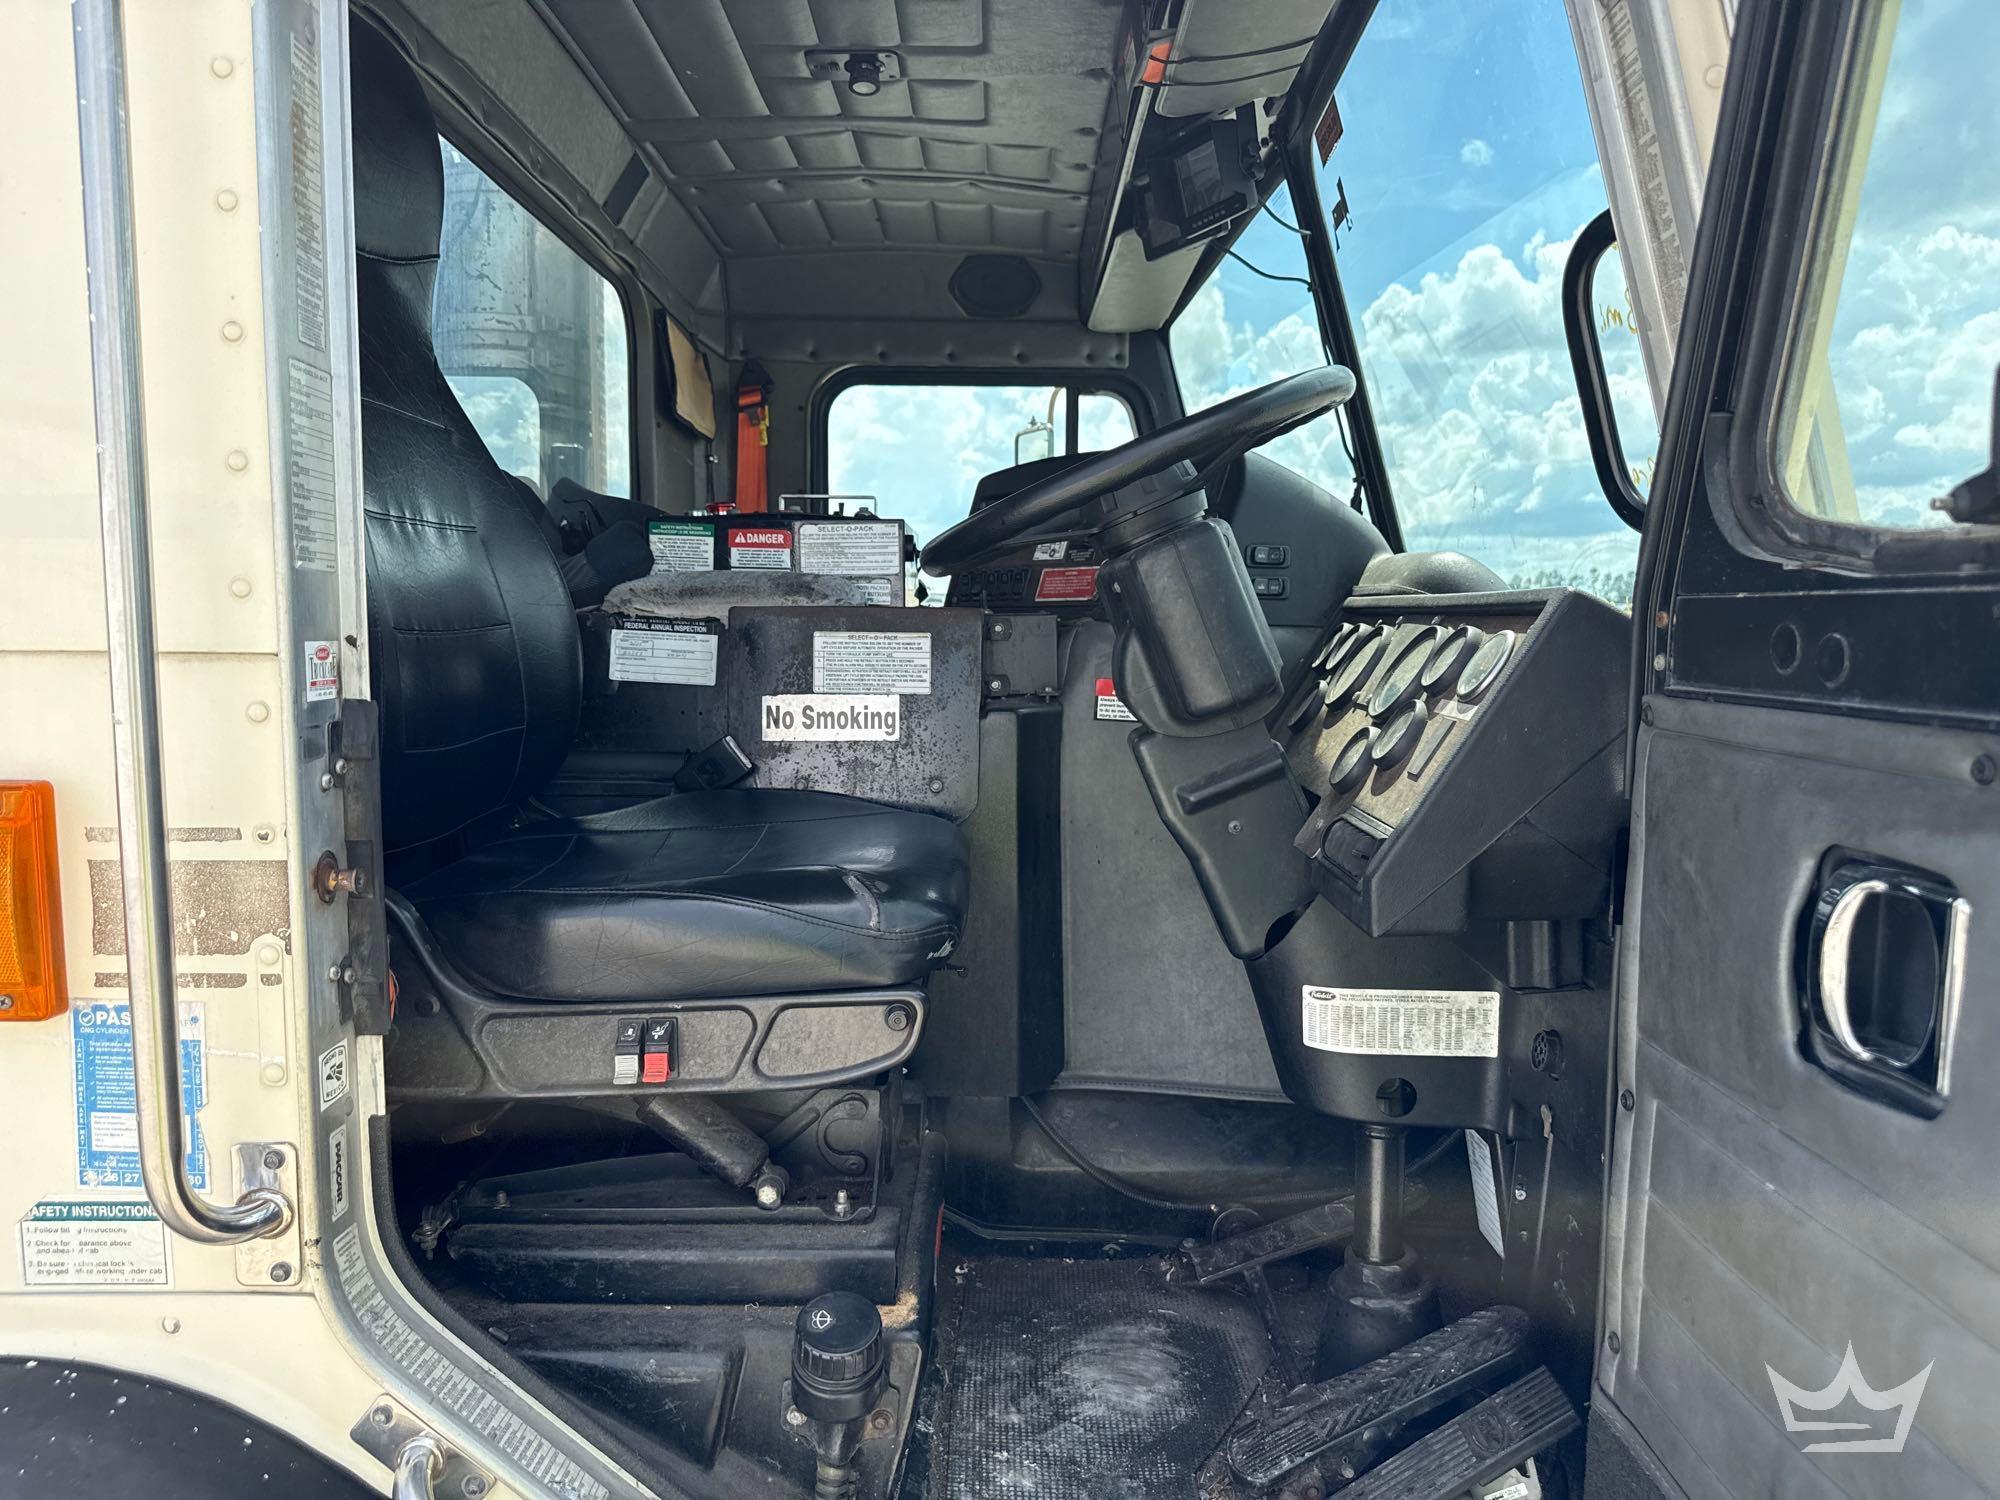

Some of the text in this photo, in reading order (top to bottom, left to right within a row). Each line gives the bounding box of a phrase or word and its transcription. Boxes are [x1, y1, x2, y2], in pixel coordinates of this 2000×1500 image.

[747, 534, 784, 543] DANGER
[766, 705, 896, 735] No Smoking
[324, 1050, 336, 1065] HECHO
[326, 1081, 344, 1098] MEXICO
[103, 1173, 119, 1182] 26
[124, 1173, 139, 1182] 27
[188, 1175, 202, 1184] 30
